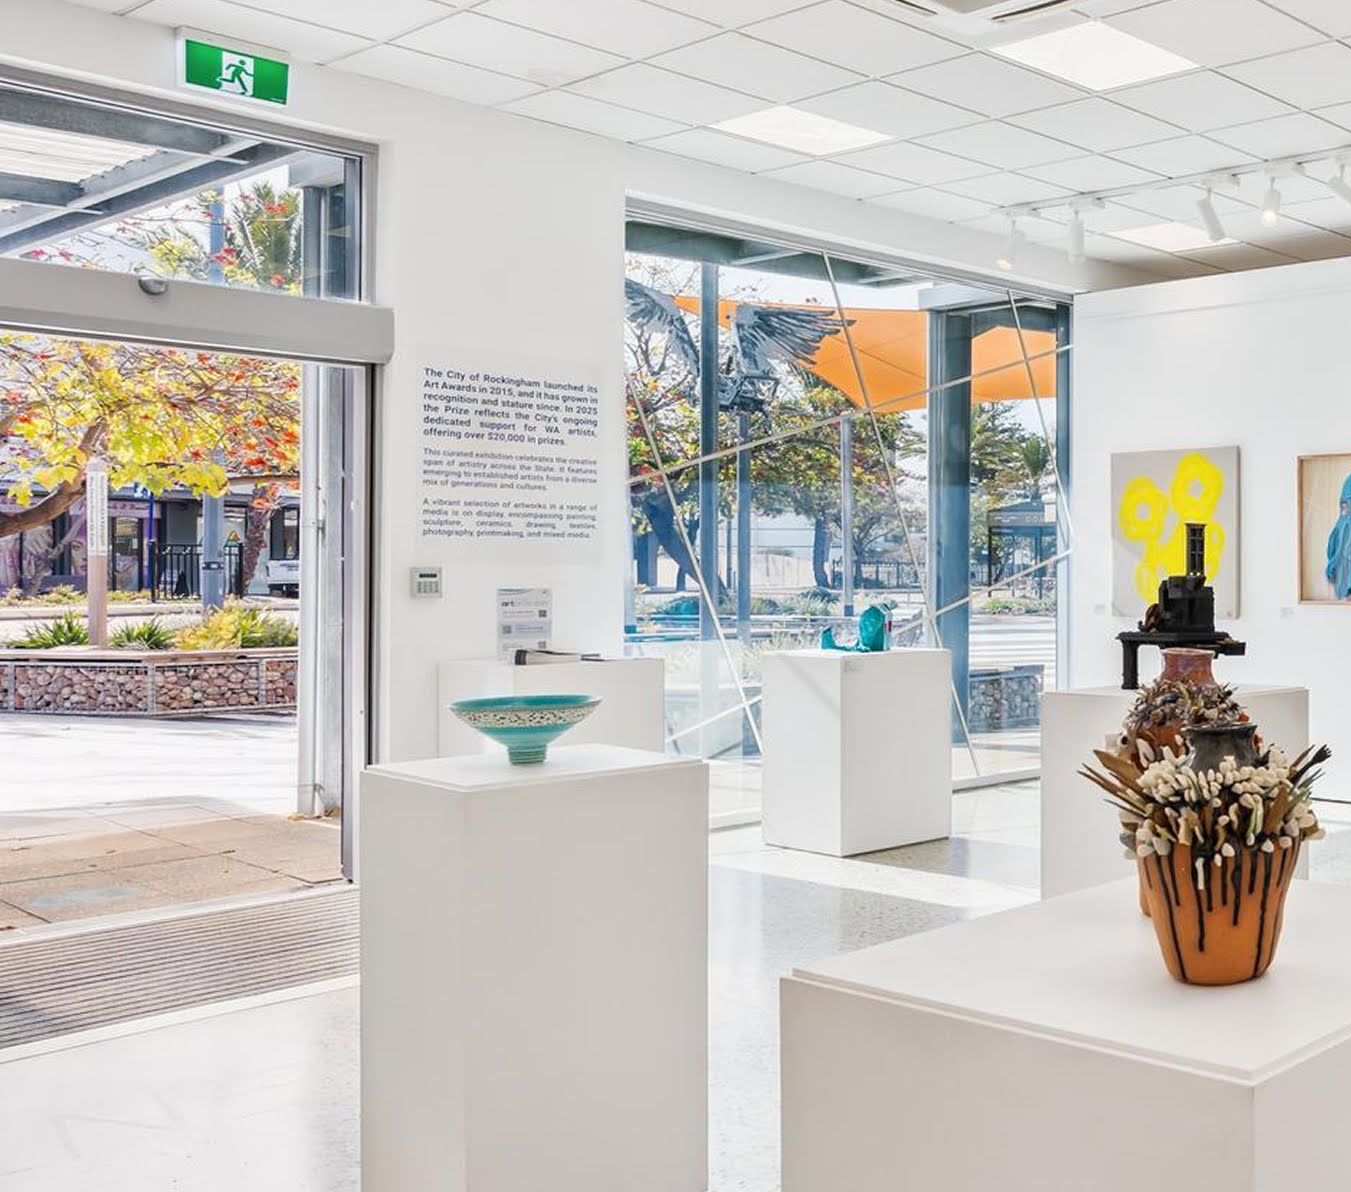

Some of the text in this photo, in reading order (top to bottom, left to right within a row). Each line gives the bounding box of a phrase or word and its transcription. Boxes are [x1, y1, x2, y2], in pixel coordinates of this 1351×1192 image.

[425, 368, 598, 393] The City of Rockingham launched its
[424, 380, 439, 389] Art
[441, 382, 477, 392] Awards
[479, 385, 488, 393] in
[490, 386, 516, 397] 2015,
[544, 392, 560, 400] has
[590, 396, 598, 404] in
[424, 393, 478, 403] recognition
[502, 401, 533, 409] stature
[565, 405, 573, 413] In
[576, 406, 598, 415] 2025
[423, 416, 471, 427] dedicated
[480, 422, 516, 431] support
[524, 423, 537, 431] for
[424, 404, 439, 412] the
[444, 405, 470, 415] Prize
[474, 409, 510, 419] reflects
[515, 412, 530, 420] the
[563, 417, 598, 427] ongoing
[423, 428, 462, 439] offering
[487, 432, 525, 443] $20,000
